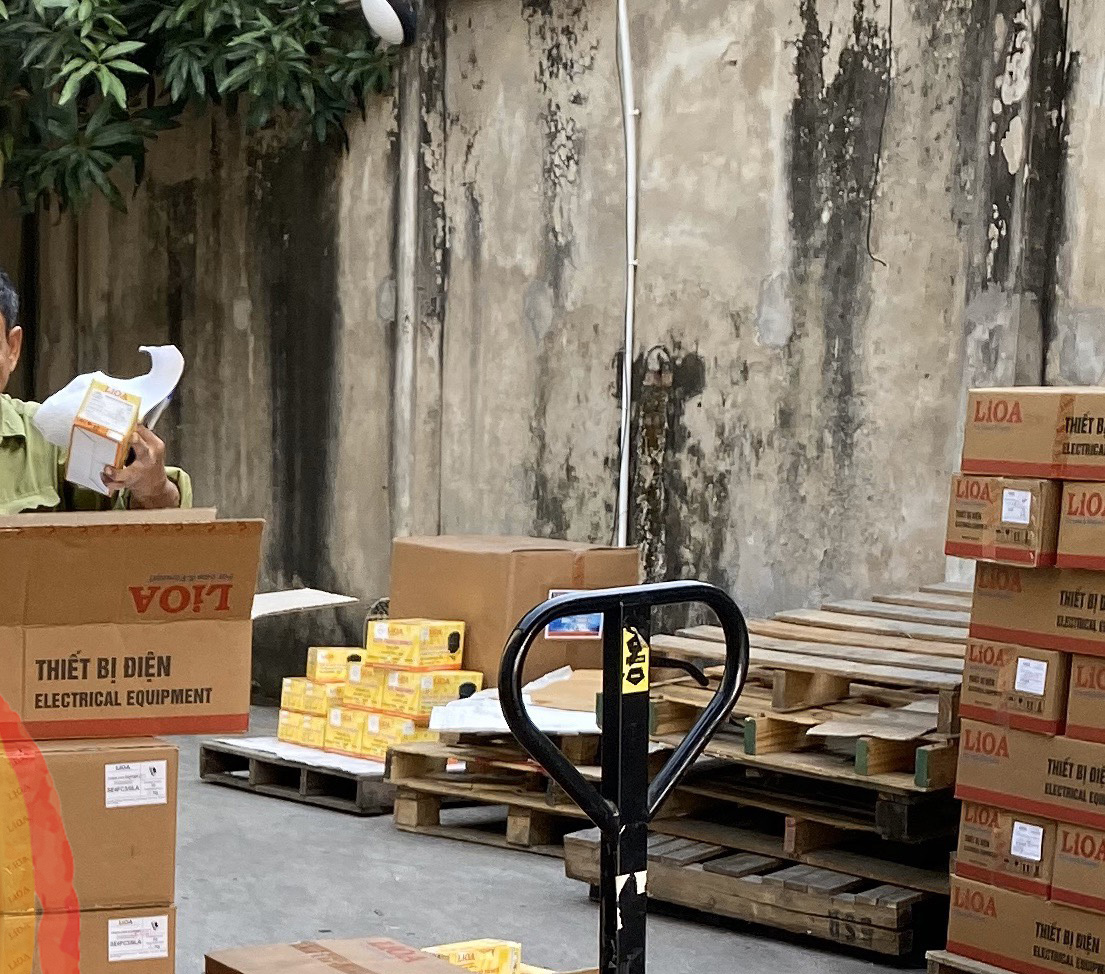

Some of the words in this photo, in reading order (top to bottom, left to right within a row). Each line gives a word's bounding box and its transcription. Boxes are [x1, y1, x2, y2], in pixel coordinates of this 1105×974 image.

[974, 399, 1023, 423] LiOA
[1065, 411, 1095, 435] THIẾT
[129, 584, 234, 613] LiOA
[35, 650, 91, 681] THIẾT
[97, 657, 118, 685] BỊ
[124, 651, 172, 683] ĐIỆN
[35, 690, 122, 709] ELECTRICAL
[127, 688, 213, 706] EQUIPMENT
[964, 729, 1009, 758] LiOA
